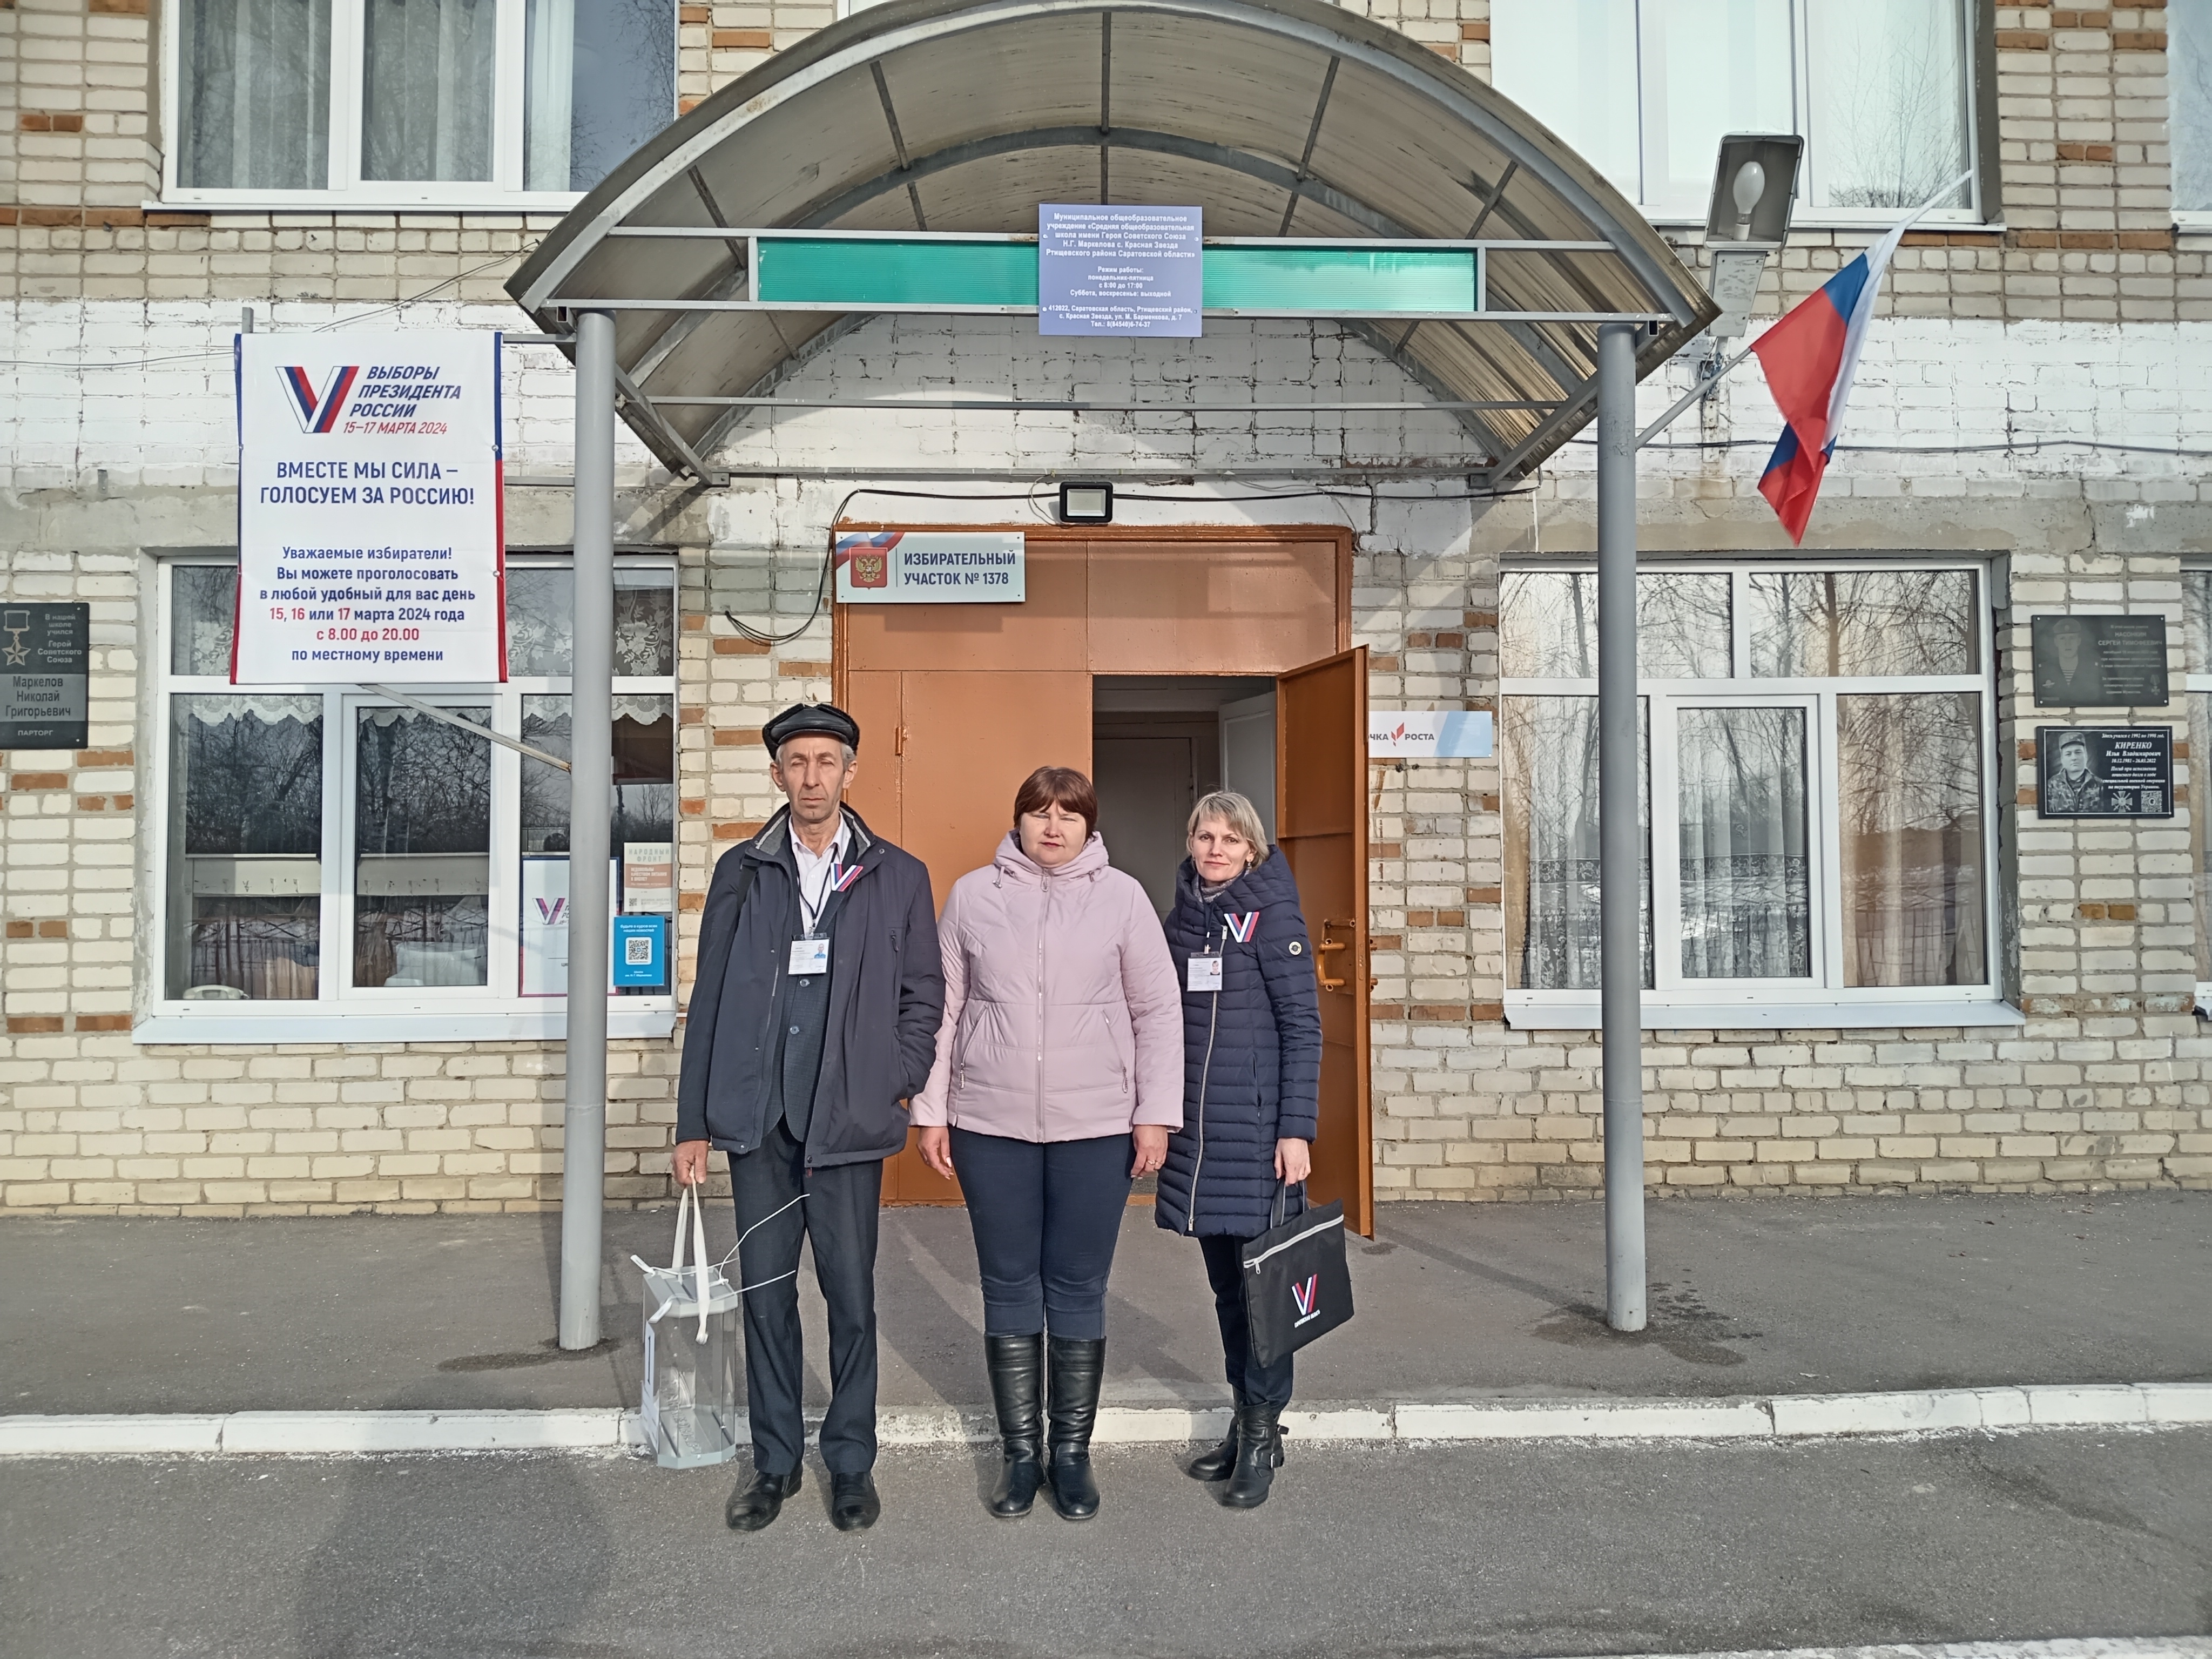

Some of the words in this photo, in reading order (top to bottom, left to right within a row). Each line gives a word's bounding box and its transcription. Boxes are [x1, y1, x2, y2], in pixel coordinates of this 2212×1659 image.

[1054, 212, 1109, 221] Муниципальное
[1110, 214, 1187, 222] общеобразовательное
[1088, 222, 1120, 231] «Средняя
[1121, 223, 1195, 232] общеобразовательная
[1101, 232, 1122, 240] Героя
[1078, 240, 1115, 248] Маркелова
[1125, 241, 1153, 249] Красная
[1154, 241, 1178, 249] Звезда
[1046, 248, 1090, 257] Ртищевского
[1092, 249, 1116, 258] района
[1118, 250, 1162, 258] Саратовской
[367, 366, 440, 379] ВЫБОРЫ
[358, 385, 461, 400] ПРЕЗИДЕНТА
[349, 404, 417, 417] РОССИИ
[376, 422, 416, 434] МАРТА
[417, 422, 447, 434] 2024
[277, 462, 348, 478] ВМЕСТЕ
[354, 462, 385, 478] МЫ
[392, 462, 441, 479] СИЛА
[260, 487, 356, 503] ГОЛОСУЕМ
[362, 488, 385, 503] ЗА
[390, 488, 474, 504] РОССИЮ!
[282, 547, 363, 559] Уважаемые
[367, 547, 452, 562] избиратели!
[904, 550, 1015, 565] ИЗБИРАТЕЛЬНЫЙ
[277, 568, 297, 579] Вы
[302, 569, 352, 579] можете
[357, 569, 458, 581] проголосовать
[904, 573, 961, 585] УЧАСТОК
[965, 573, 979, 584] №
[982, 572, 1009, 584] 1378
[260, 591, 267, 599] в
[271, 588, 316, 600] любой
[321, 588, 382, 603] удобный
[386, 590, 411, 601] для
[416, 590, 439, 600] вас
[442, 591, 475, 601] день
[270, 608, 287, 622] 15,
[291, 608, 305, 620] 16
[309, 611, 334, 620] или
[338, 608, 350, 620] 17
[354, 611, 394, 623] марта
[398, 608, 431, 620] 2024
[435, 611, 464, 622] года
[317, 631, 324, 640] с
[328, 628, 356, 640] 8.00
[361, 631, 378, 642] до
[382, 629, 419, 640] 20.00
[49, 640, 71, 649] Герой
[292, 651, 307, 660] по
[312, 650, 380, 663] местному
[384, 651, 443, 663] времени
[13, 676, 63, 688] Маркелов
[17, 691, 59, 702] Николай
[5, 705, 70, 719] Григорьевич
